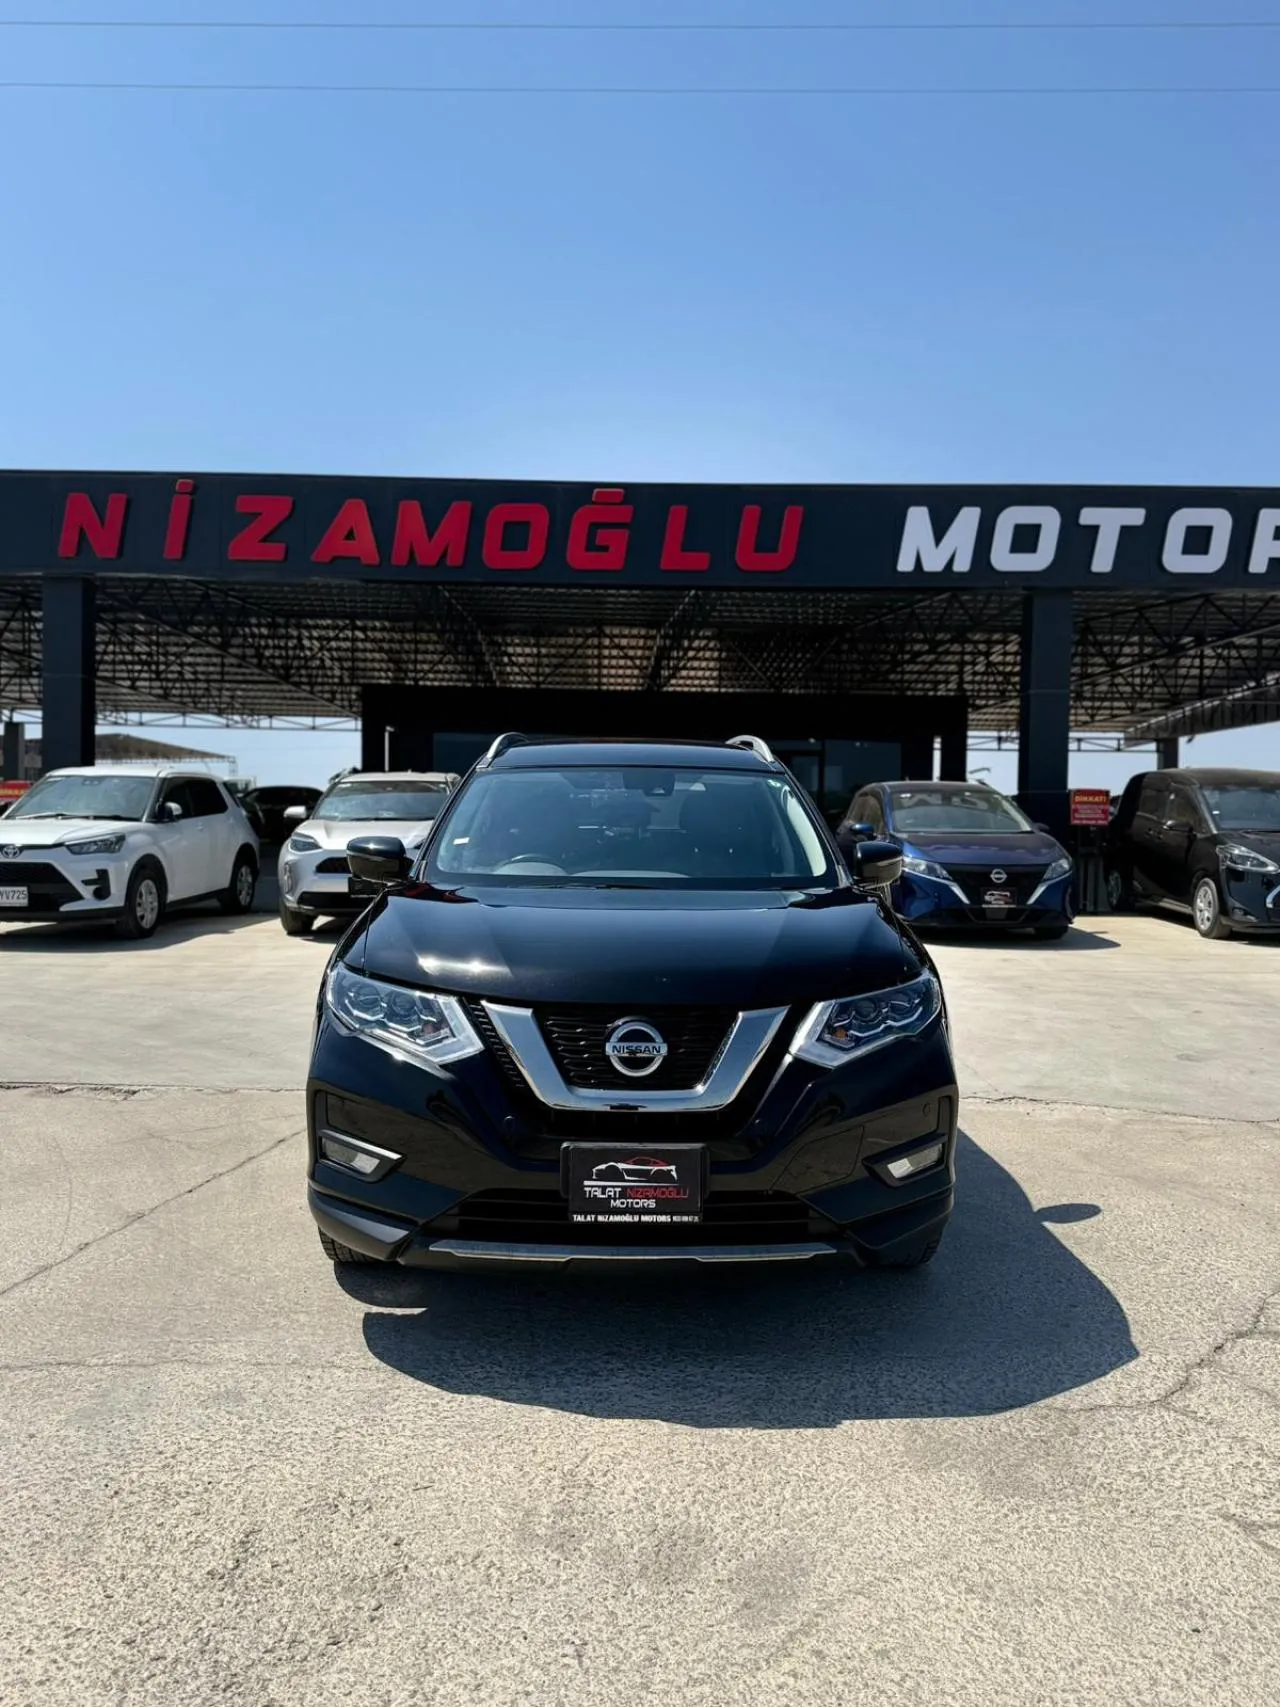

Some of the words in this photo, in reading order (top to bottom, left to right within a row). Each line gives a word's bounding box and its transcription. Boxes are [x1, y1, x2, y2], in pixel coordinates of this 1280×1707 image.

[58, 479, 804, 572] NİZAMOĞLU
[611, 1045, 662, 1054] NISSAN
[583, 1187, 622, 1198] TALAT
[610, 1199, 656, 1209] MOTORS
[572, 1214, 596, 1222] TALAT
[640, 1214, 671, 1222] MOTORS
